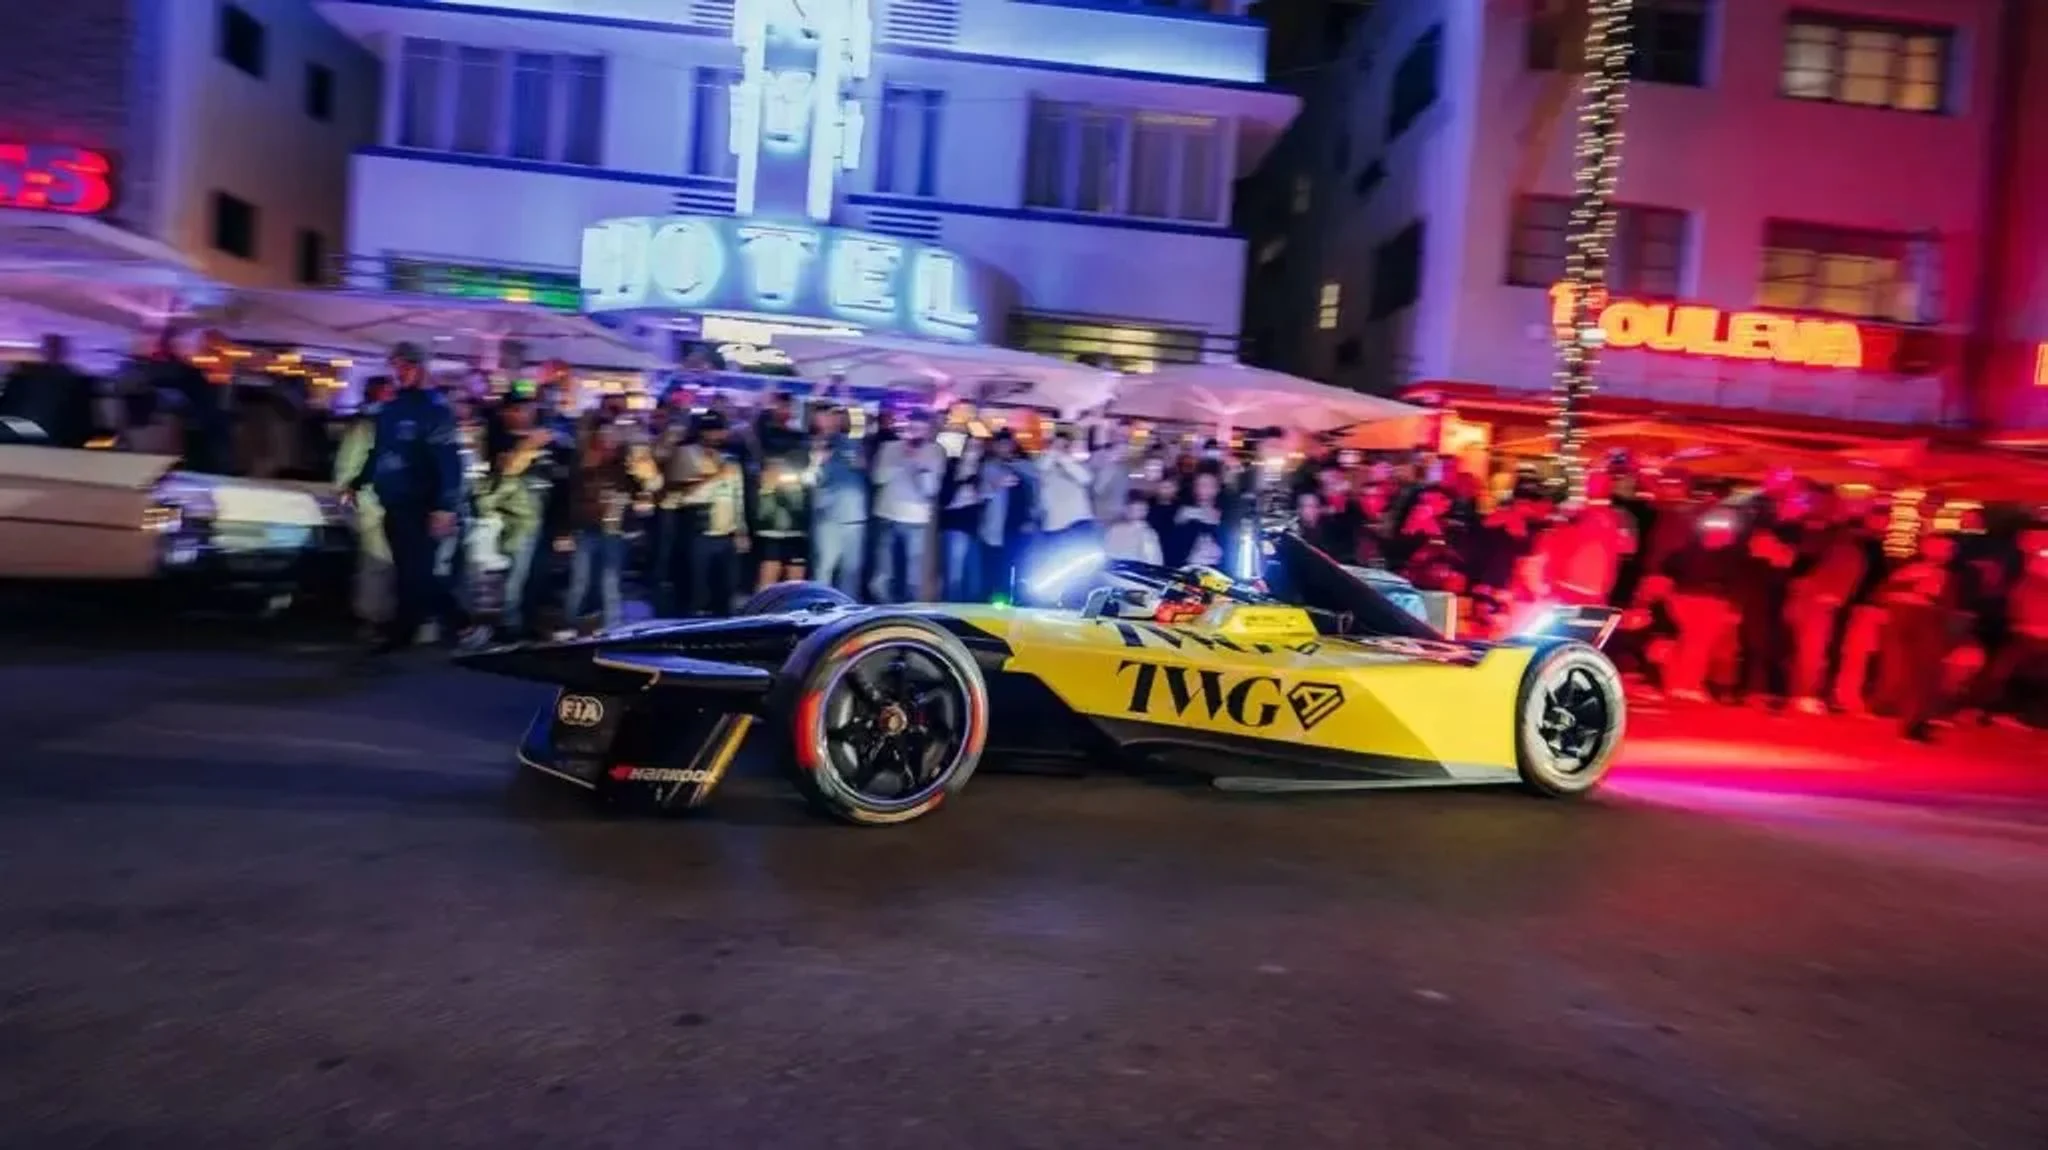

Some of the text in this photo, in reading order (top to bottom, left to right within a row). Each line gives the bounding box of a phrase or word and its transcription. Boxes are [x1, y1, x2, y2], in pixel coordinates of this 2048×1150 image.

[579, 219, 978, 339] HOTEL
[560, 698, 602, 725] FIA
[1116, 660, 1282, 728] TWG
